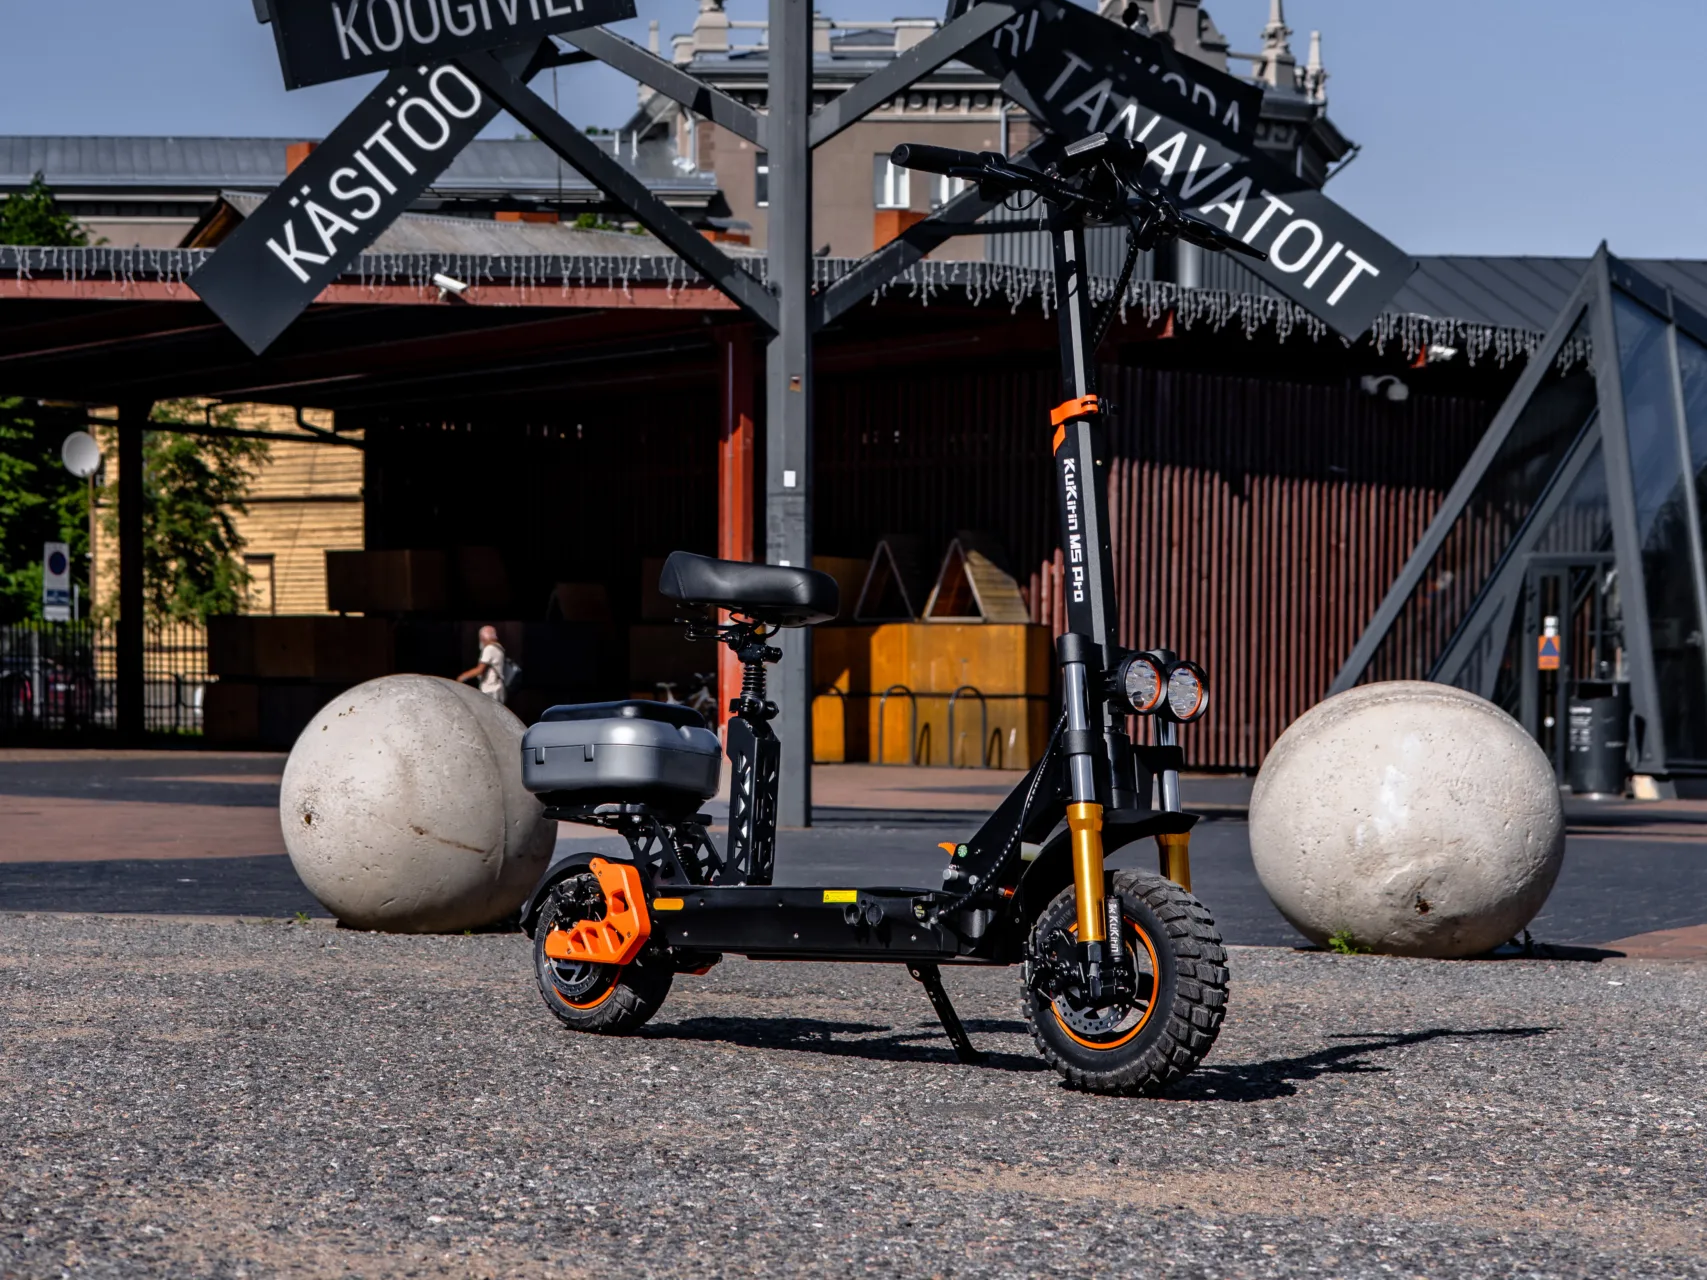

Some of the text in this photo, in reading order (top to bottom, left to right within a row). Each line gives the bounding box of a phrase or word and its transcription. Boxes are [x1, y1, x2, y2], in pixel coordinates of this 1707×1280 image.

[265, 64, 483, 284] KÄSITÖÖ
[1063, 458, 1079, 531] KuKirin
[1071, 566, 1085, 603] Pro
